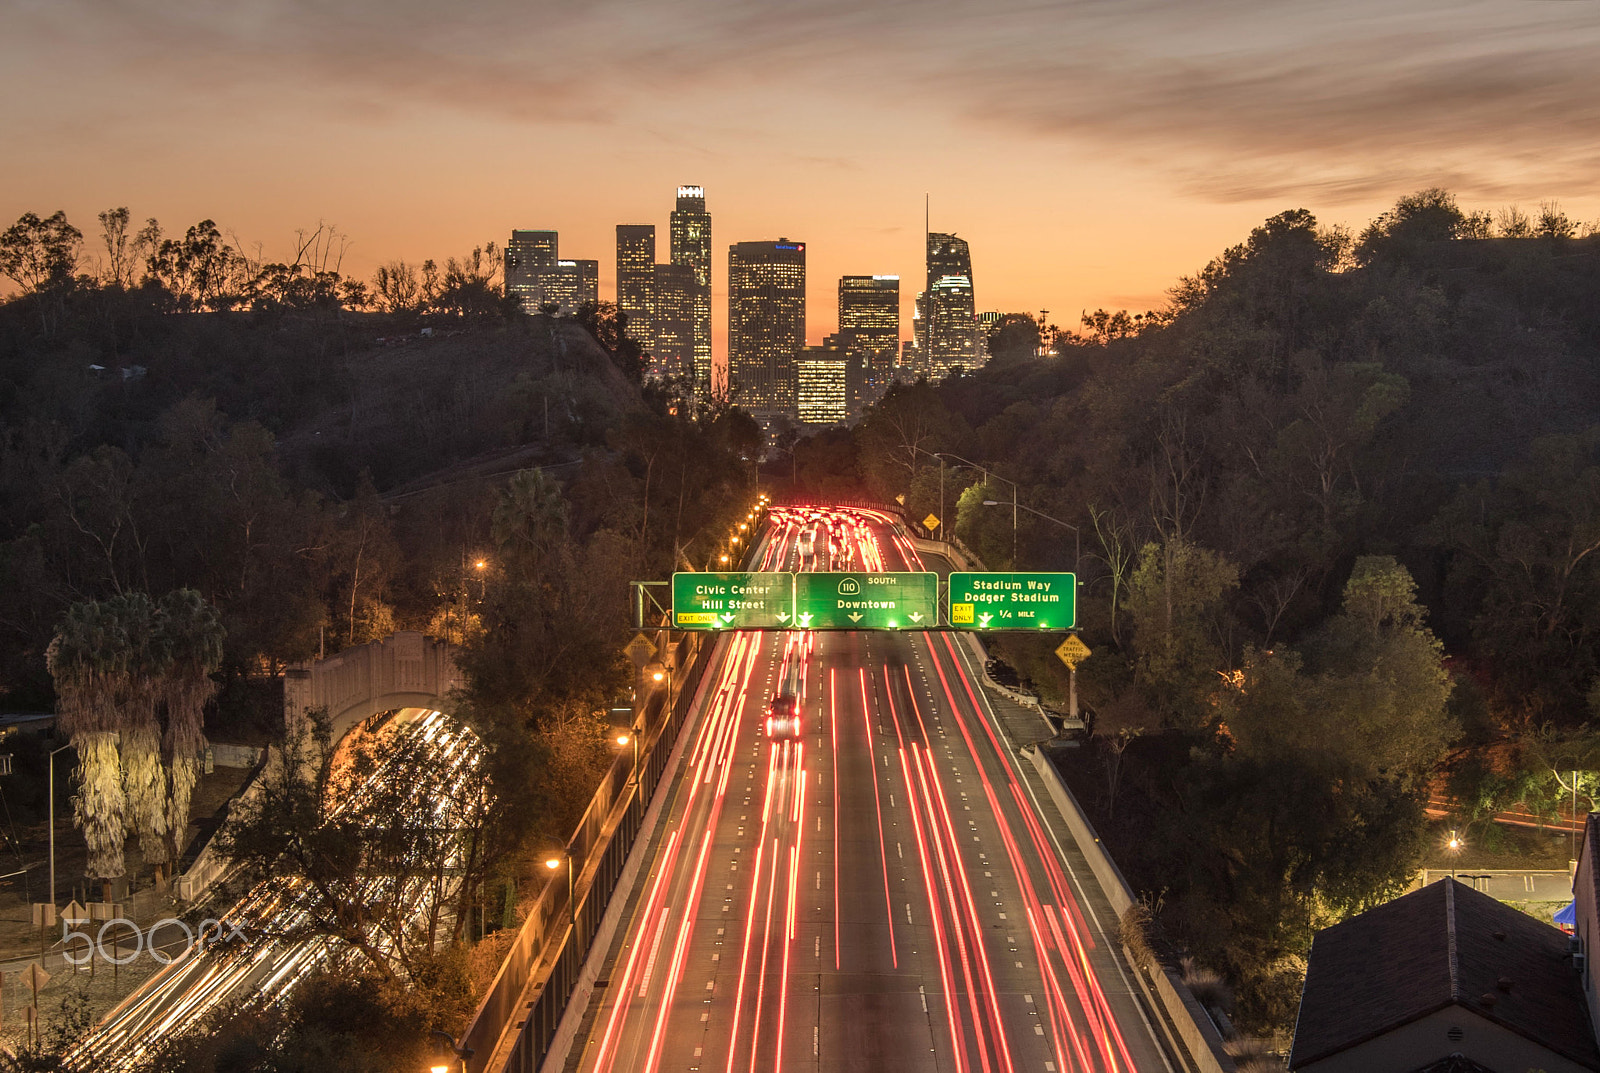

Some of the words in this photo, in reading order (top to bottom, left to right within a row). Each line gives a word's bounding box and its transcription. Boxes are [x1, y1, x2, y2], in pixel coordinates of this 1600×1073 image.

[868, 577, 897, 585] SOUTH
[696, 585, 726, 594] Civic
[731, 585, 770, 594] Center
[843, 583, 855, 592] 110
[973, 581, 1022, 590] Stadium
[1027, 581, 1051, 592] Way
[964, 593, 1005, 604] Dodger
[1011, 593, 1059, 602] Stadium
[702, 600, 723, 609] Hill
[728, 600, 765, 609] Street
[837, 600, 896, 609] Downtown
